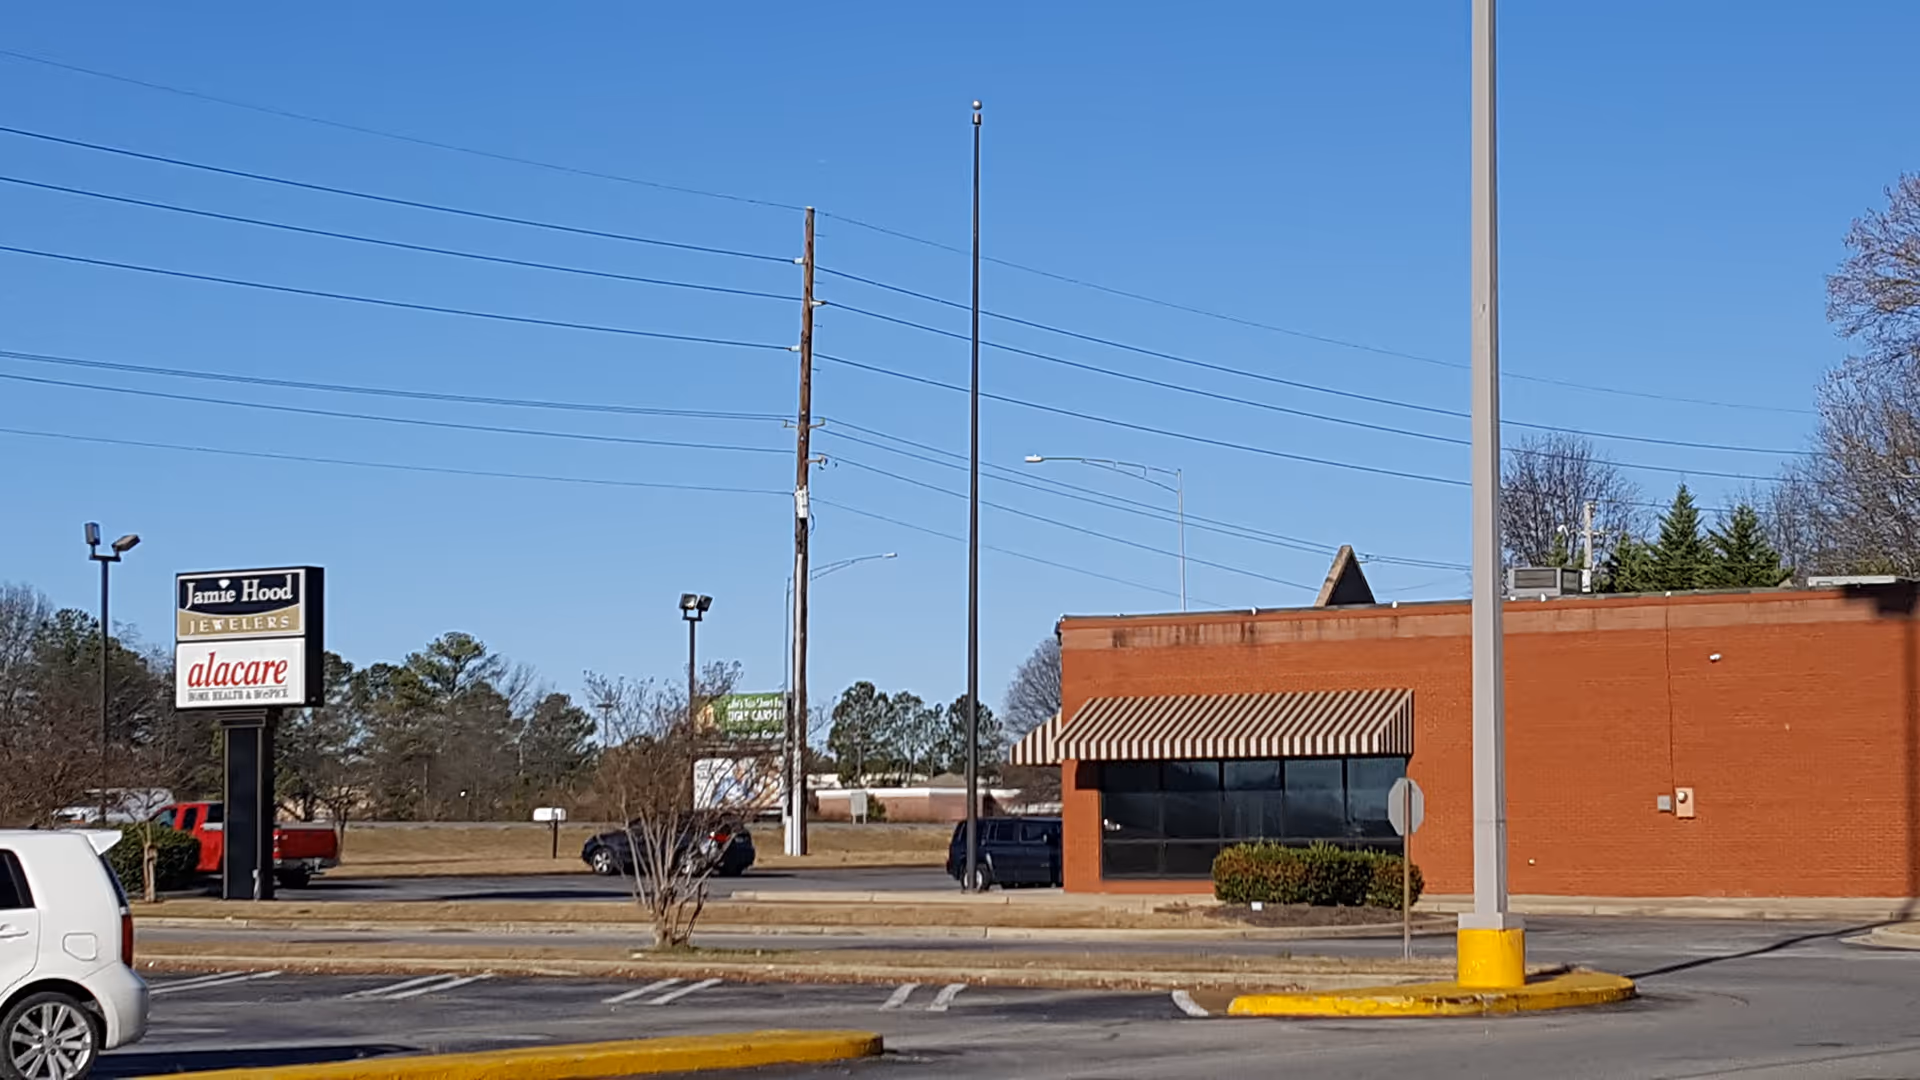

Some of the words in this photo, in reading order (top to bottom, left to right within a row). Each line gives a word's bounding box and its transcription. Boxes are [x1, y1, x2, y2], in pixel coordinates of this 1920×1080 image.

[185, 579, 236, 610] Jamie
[240, 574, 293, 602] Hood
[189, 616, 290, 636] JEWELERS
[187, 651, 288, 688] alacare
[188, 691, 210, 702] HOME
[212, 690, 243, 701] HEALTH
[245, 690, 252, 699] &
